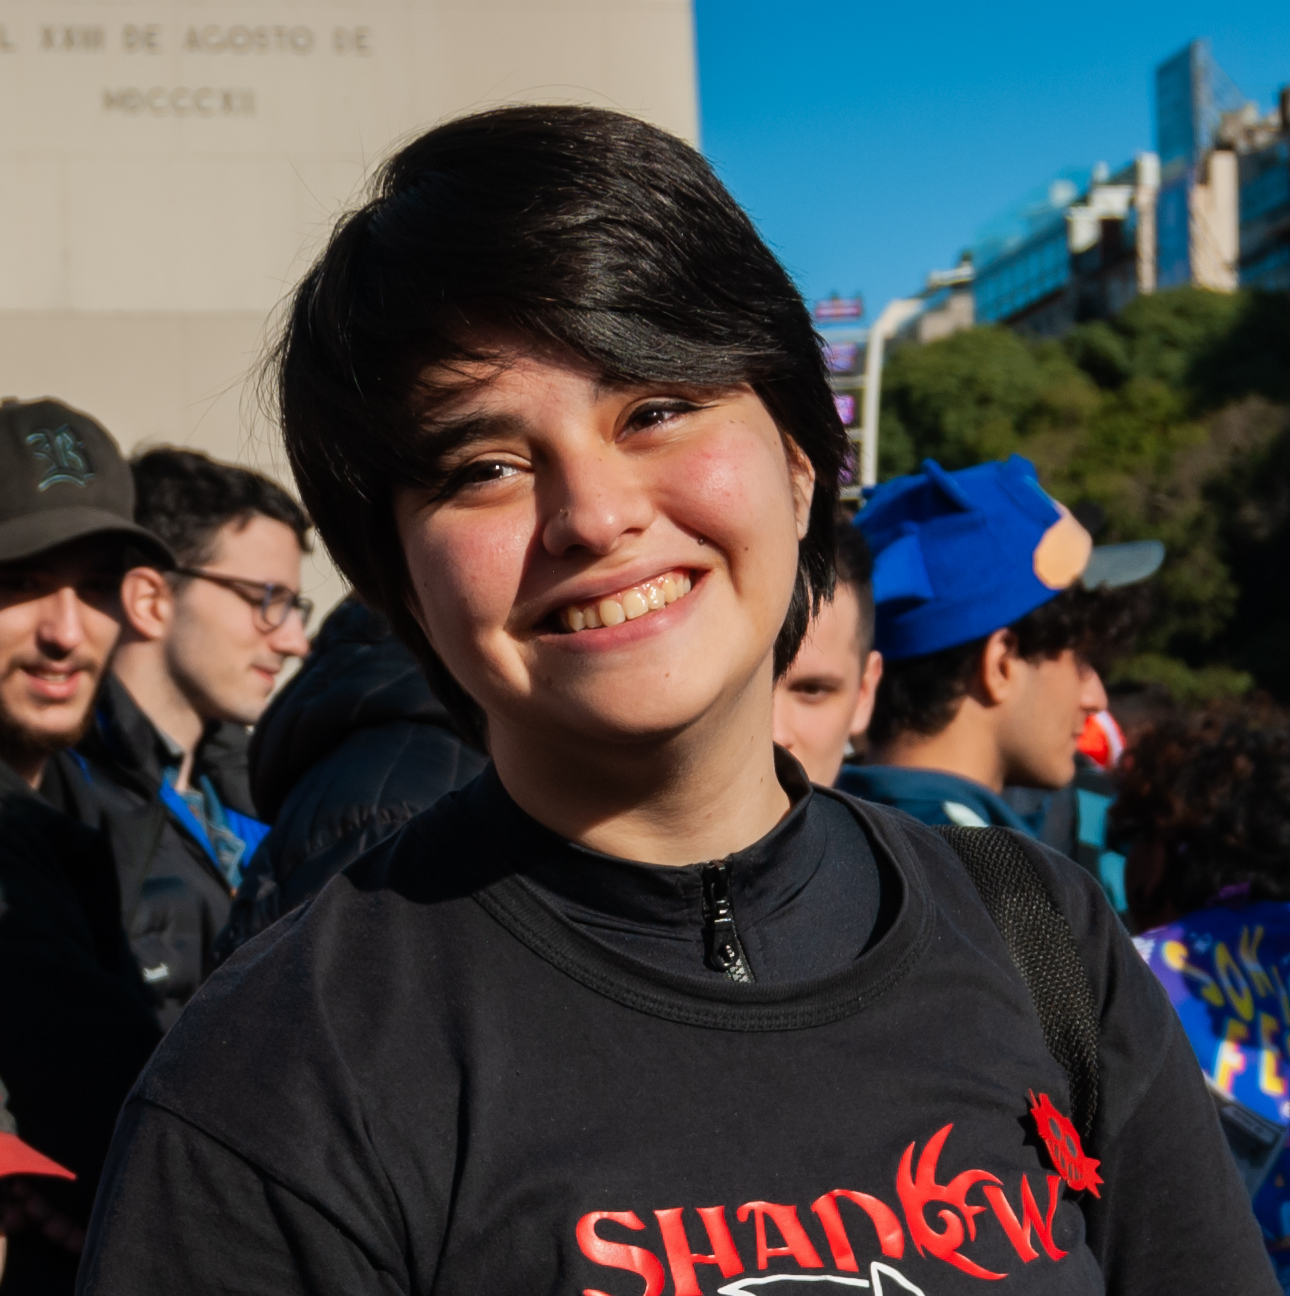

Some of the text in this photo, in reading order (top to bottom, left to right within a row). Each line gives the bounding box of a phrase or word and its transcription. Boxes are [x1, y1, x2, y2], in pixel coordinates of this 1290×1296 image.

[123, 23, 161, 54] DE
[183, 24, 314, 55] AGOSTO
[332, 25, 373, 57] DE
